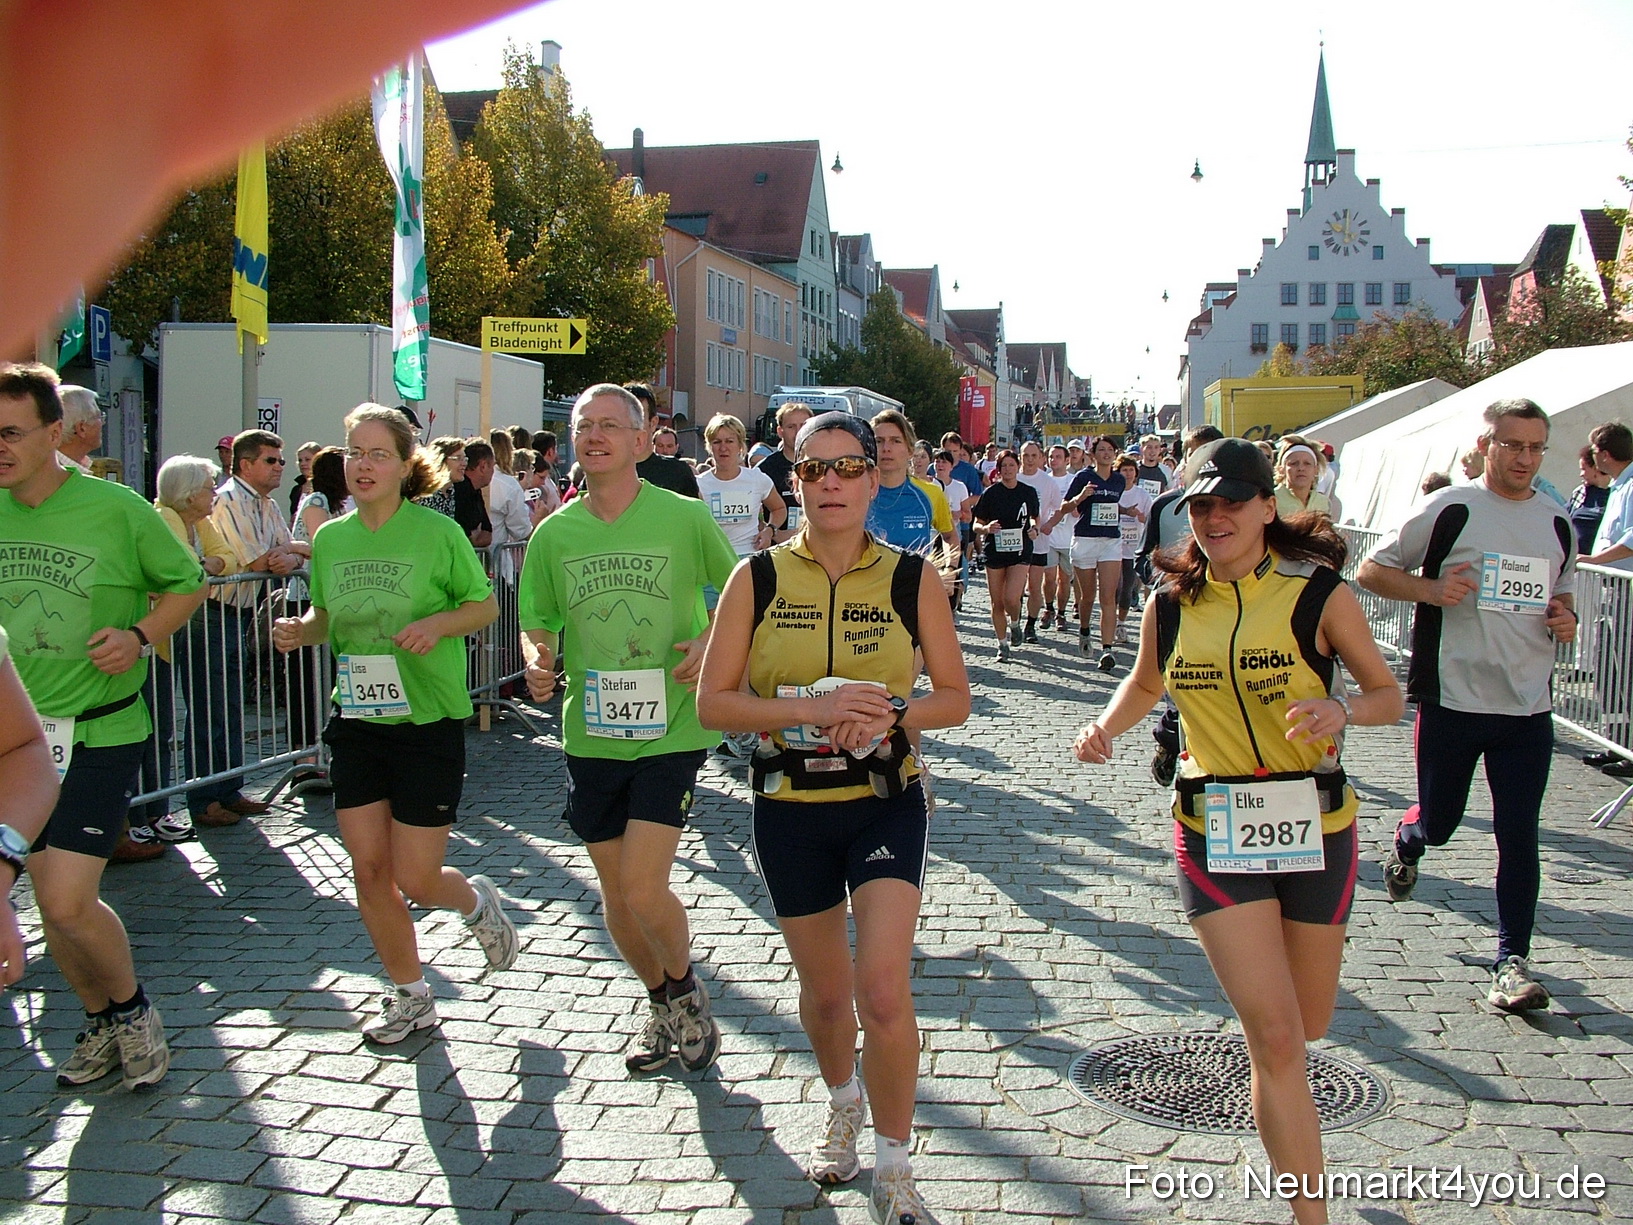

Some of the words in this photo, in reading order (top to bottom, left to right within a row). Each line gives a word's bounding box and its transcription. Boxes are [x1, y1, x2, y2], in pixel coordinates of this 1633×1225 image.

[95, 314, 106, 352] P
[490, 321, 558, 334] Treffpunkt
[490, 337, 562, 351] Bladenight
[1071, 425, 1099, 434] START
[724, 504, 750, 515] 3731
[1002, 538, 1021, 546] 3032
[343, 563, 399, 577] ATEMLOS
[582, 557, 653, 578] ATEMLOS
[1501, 559, 1530, 573] Roland
[2, 563, 72, 589] ETTINGEN
[338, 575, 398, 593] DETTINGEN
[578, 573, 654, 598] DETTINGEN
[1500, 579, 1543, 599] 2992
[844, 602, 869, 610] sport
[770, 611, 823, 620] RAMSAUER
[841, 606, 894, 623] SCHÖLL
[776, 622, 816, 630] Allersberg
[844, 627, 889, 642] Running-
[852, 641, 879, 656] Team
[1241, 648, 1268, 656] sport
[1240, 650, 1295, 670] SCHÖLL
[351, 661, 367, 674] Lisa
[1170, 671, 1223, 680] RAMSAUER
[1245, 671, 1292, 692] Running-
[601, 678, 637, 691] Stefan
[805, 685, 839, 698] San
[1175, 682, 1219, 691] Allersberg
[356, 683, 400, 701] 3476
[1257, 690, 1286, 706] Team
[606, 700, 659, 720] 3477
[42, 720, 56, 733] im
[52, 745, 64, 763] 8
[1235, 792, 1264, 809] Elke
[1210, 819, 1218, 831] C
[1240, 820, 1312, 848] 2987
[865, 853, 895, 862] adidas
[1279, 856, 1322, 867] PFLEIDERER
